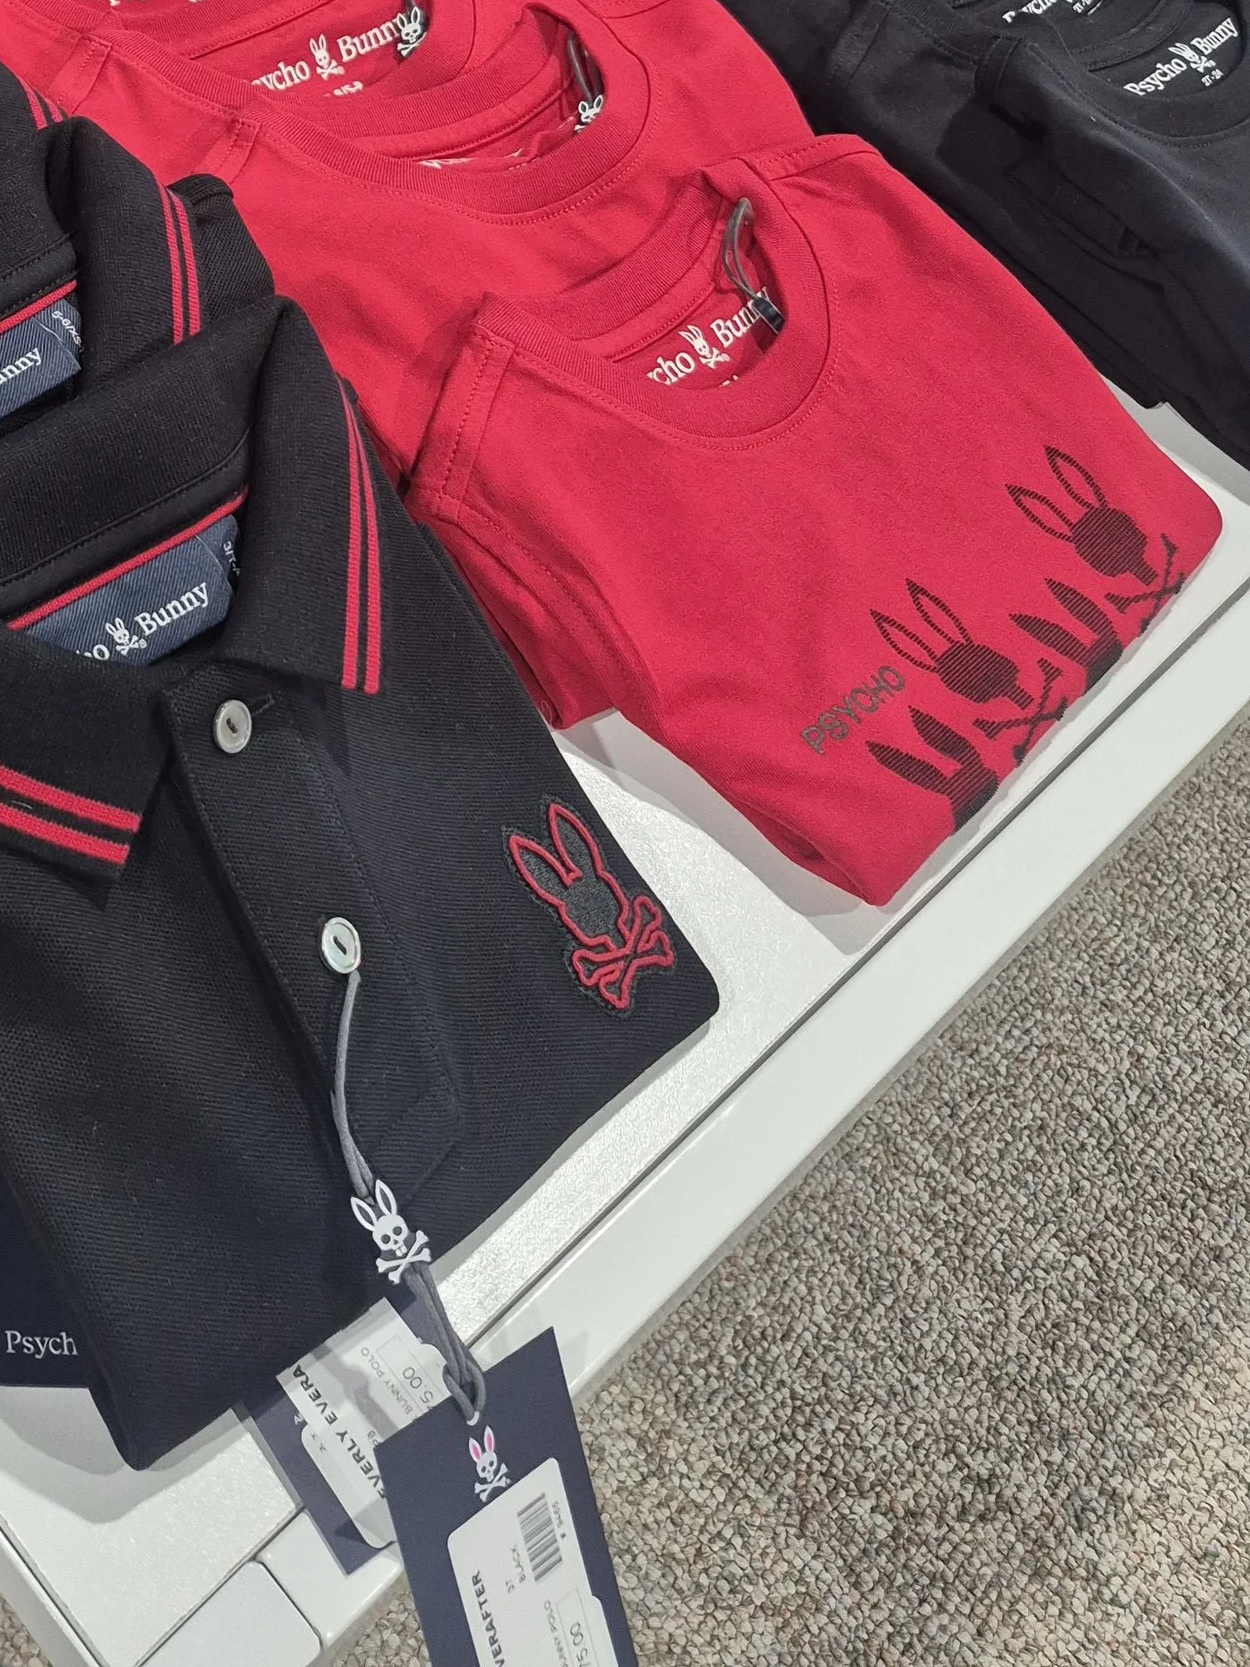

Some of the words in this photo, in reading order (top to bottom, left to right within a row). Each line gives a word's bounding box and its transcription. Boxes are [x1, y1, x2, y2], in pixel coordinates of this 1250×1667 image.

[1123, 58, 1188, 96] Psycho
[1190, 17, 1239, 55] Bunny
[645, 351, 696, 385] cho
[134, 581, 210, 637] Bunny
[800, 665, 906, 756] PSYCHO
[4, 1330, 79, 1359] Psych
[360, 1346, 385, 1376] POLO
[383, 1378, 413, 1415] BUNNY
